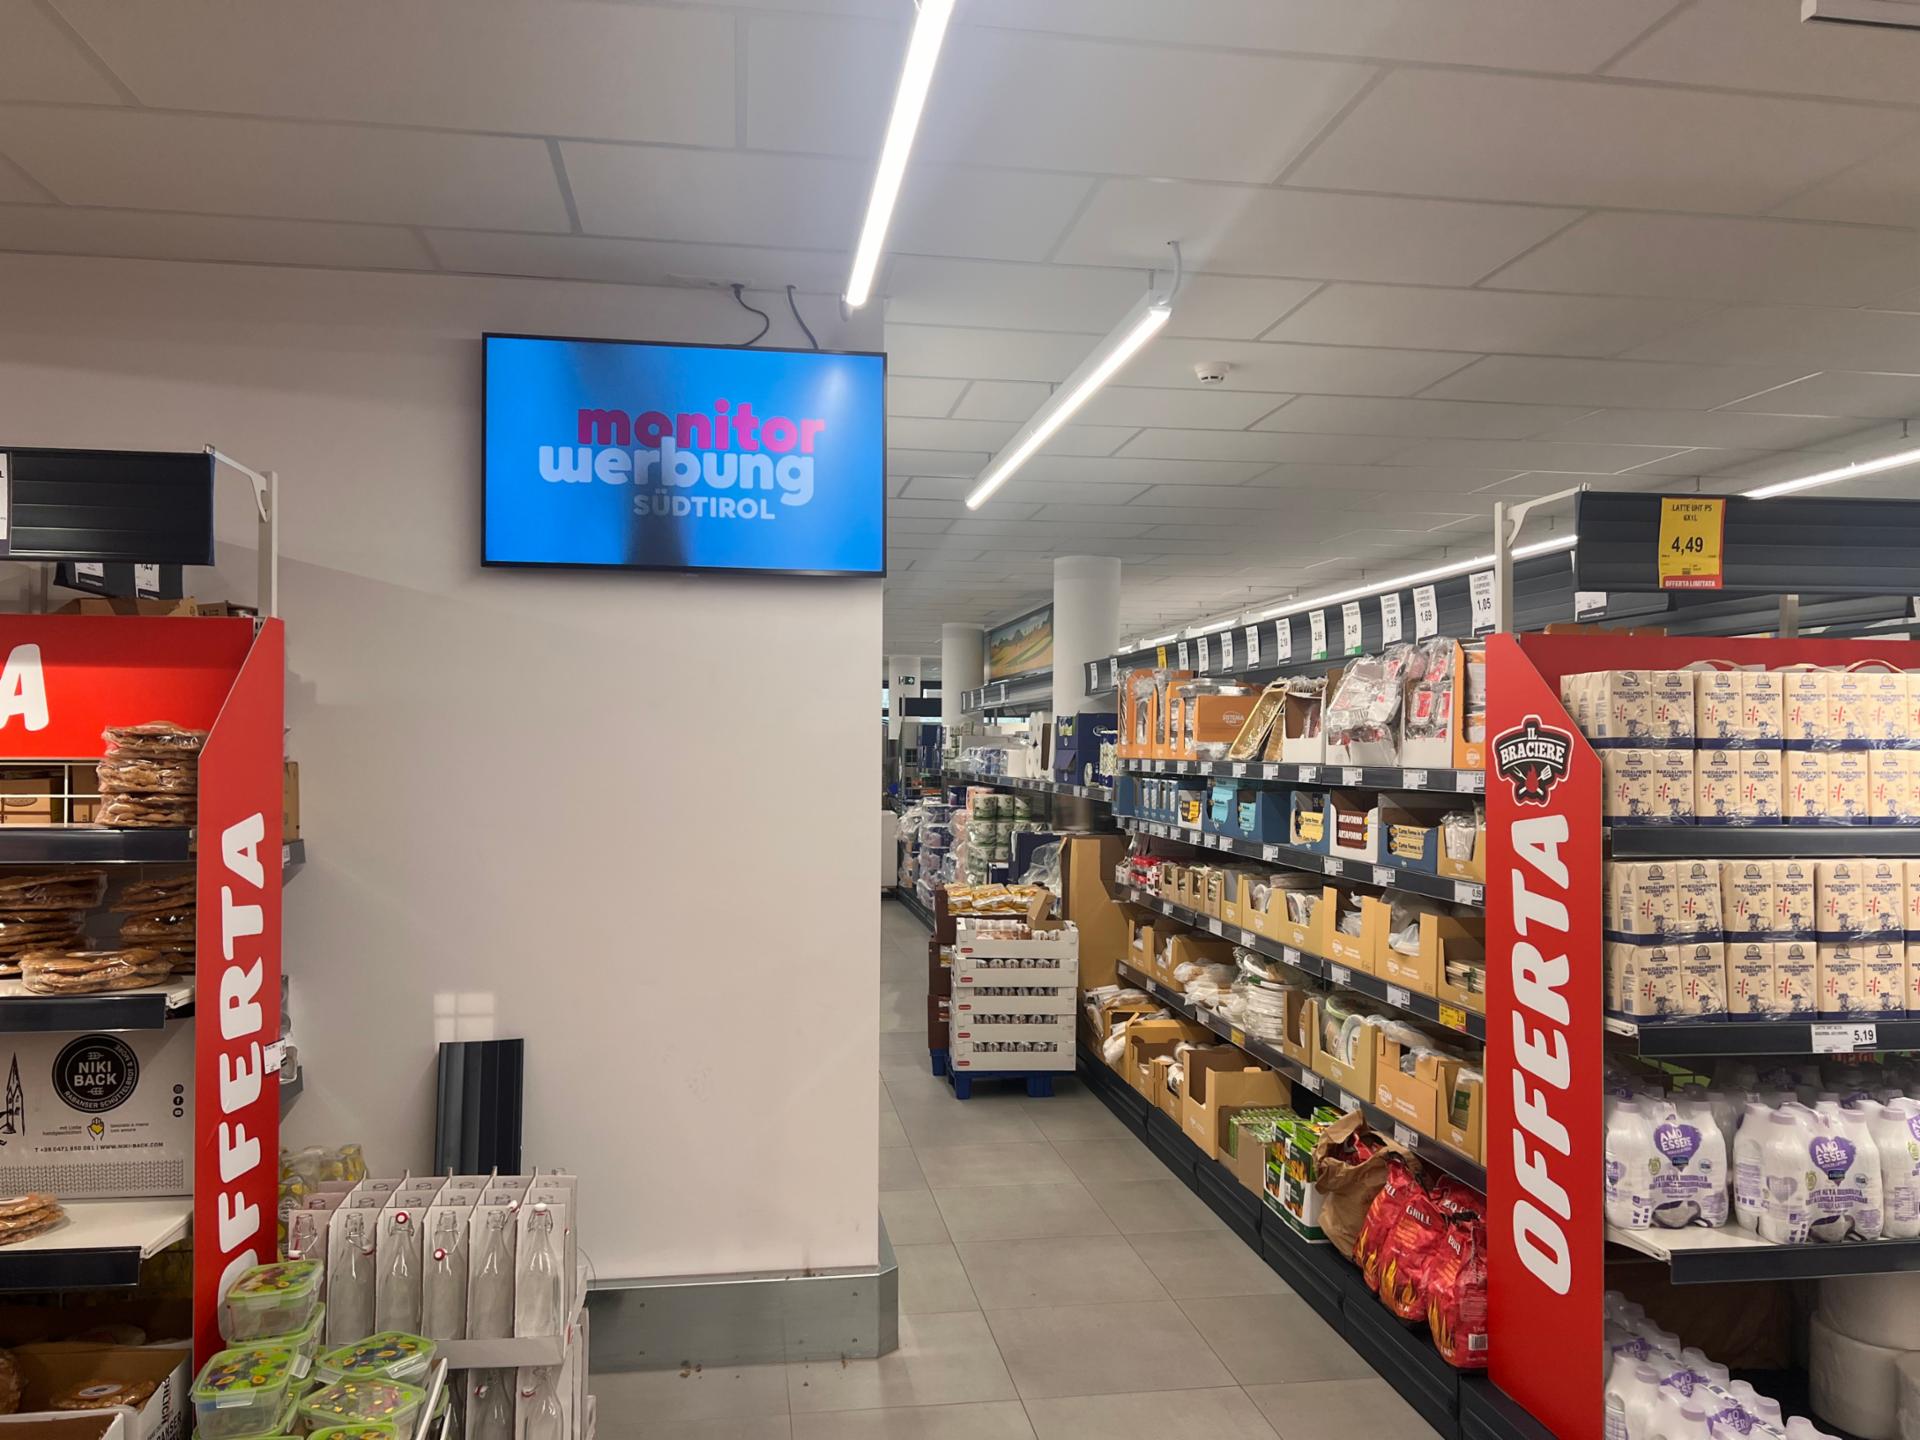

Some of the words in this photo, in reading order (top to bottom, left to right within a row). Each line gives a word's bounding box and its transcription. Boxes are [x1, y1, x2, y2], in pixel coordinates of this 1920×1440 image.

[577, 398, 826, 454] monitor
[538, 435, 814, 506] werbung
[633, 488, 776, 520] SÜDTIROL
[1672, 536, 1704, 556] 4,49
[1477, 597, 1492, 612] 1,05
[1527, 728, 1538, 740] IL
[1500, 742, 1565, 766] BRACIERE
[1854, 1030, 1874, 1042] 5,19
[1511, 814, 1572, 1295] OFFERTA
[78, 1061, 112, 1074] NIKI
[64, 1090, 98, 1108] RABANSER
[100, 1068, 134, 1108] SCHÜTTELBROT
[74, 1073, 117, 1087] BACK
[1660, 1128, 1682, 1142] AMO
[1816, 1141, 1838, 1155] AMO
[1406, 1205, 1432, 1225] GRILL
